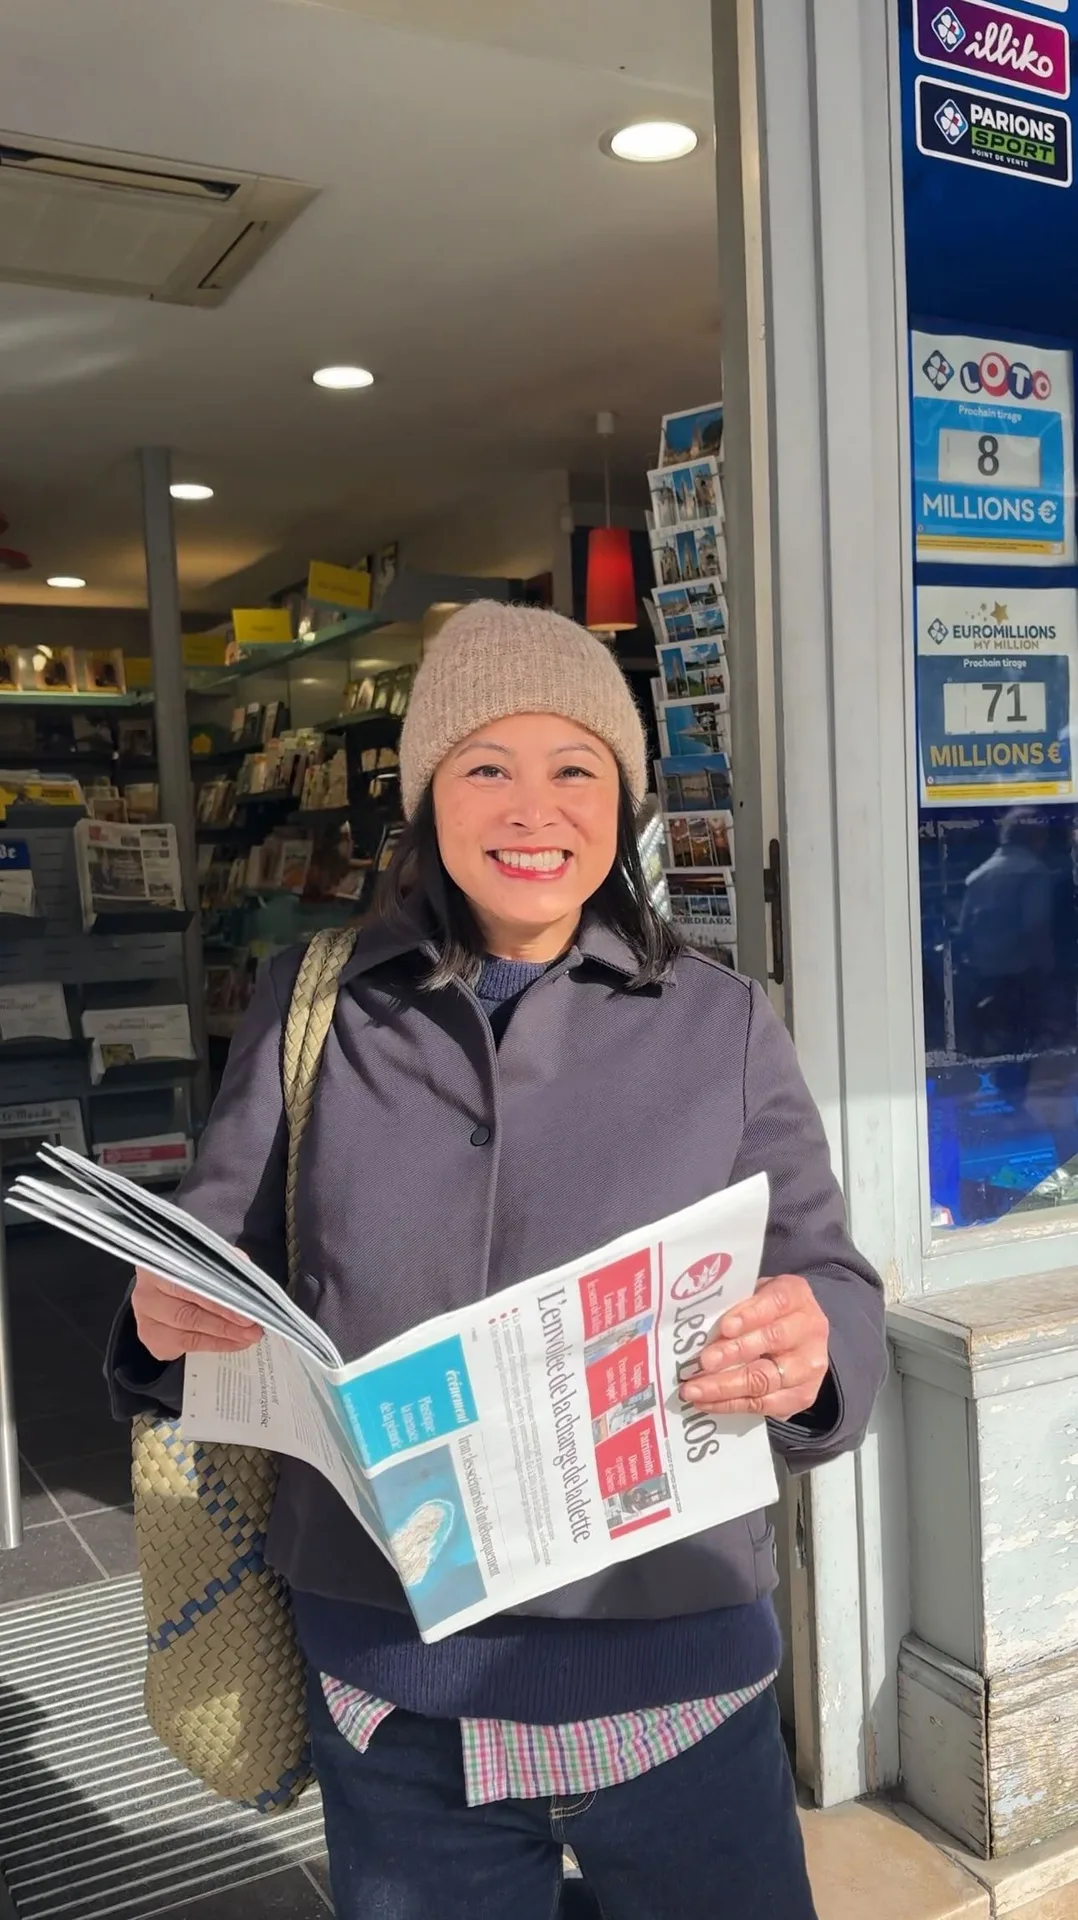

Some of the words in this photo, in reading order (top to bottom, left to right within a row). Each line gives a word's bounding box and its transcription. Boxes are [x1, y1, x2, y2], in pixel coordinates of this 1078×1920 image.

[964, 22, 1053, 78] illiko
[970, 103, 1055, 143] PARIONS
[971, 148, 993, 159] POINT
[995, 153, 1004, 162] DE
[1006, 156, 1029, 167] VENTE
[974, 130, 1053, 161] SPORT
[960, 352, 1052, 400] LOTO
[958, 404, 996, 419] Prochain
[997, 409, 1022, 423] tirage
[977, 434, 999, 476] 8
[922, 493, 1035, 522] MILLIONS
[953, 624, 1057, 640] EUROMILLIONS
[974, 640, 992, 650] MY
[994, 640, 1040, 650] MILLION
[963, 658, 1000, 668] Prochain
[1002, 658, 1027, 670] tirage
[982, 683, 1028, 722] 71
[930, 743, 1044, 768] MILLIONS
[1048, 742, 1062, 764] €
[537, 1285, 572, 1376] L'envolée
[673, 1285, 723, 1357] Les
[548, 1374, 574, 1398] de
[552, 1389, 575, 1418] la
[553, 1415, 579, 1469] charge
[639, 1427, 654, 1474] Patrimoine
[562, 1465, 585, 1488] de
[565, 1480, 588, 1503] la
[566, 1499, 590, 1544] dette
